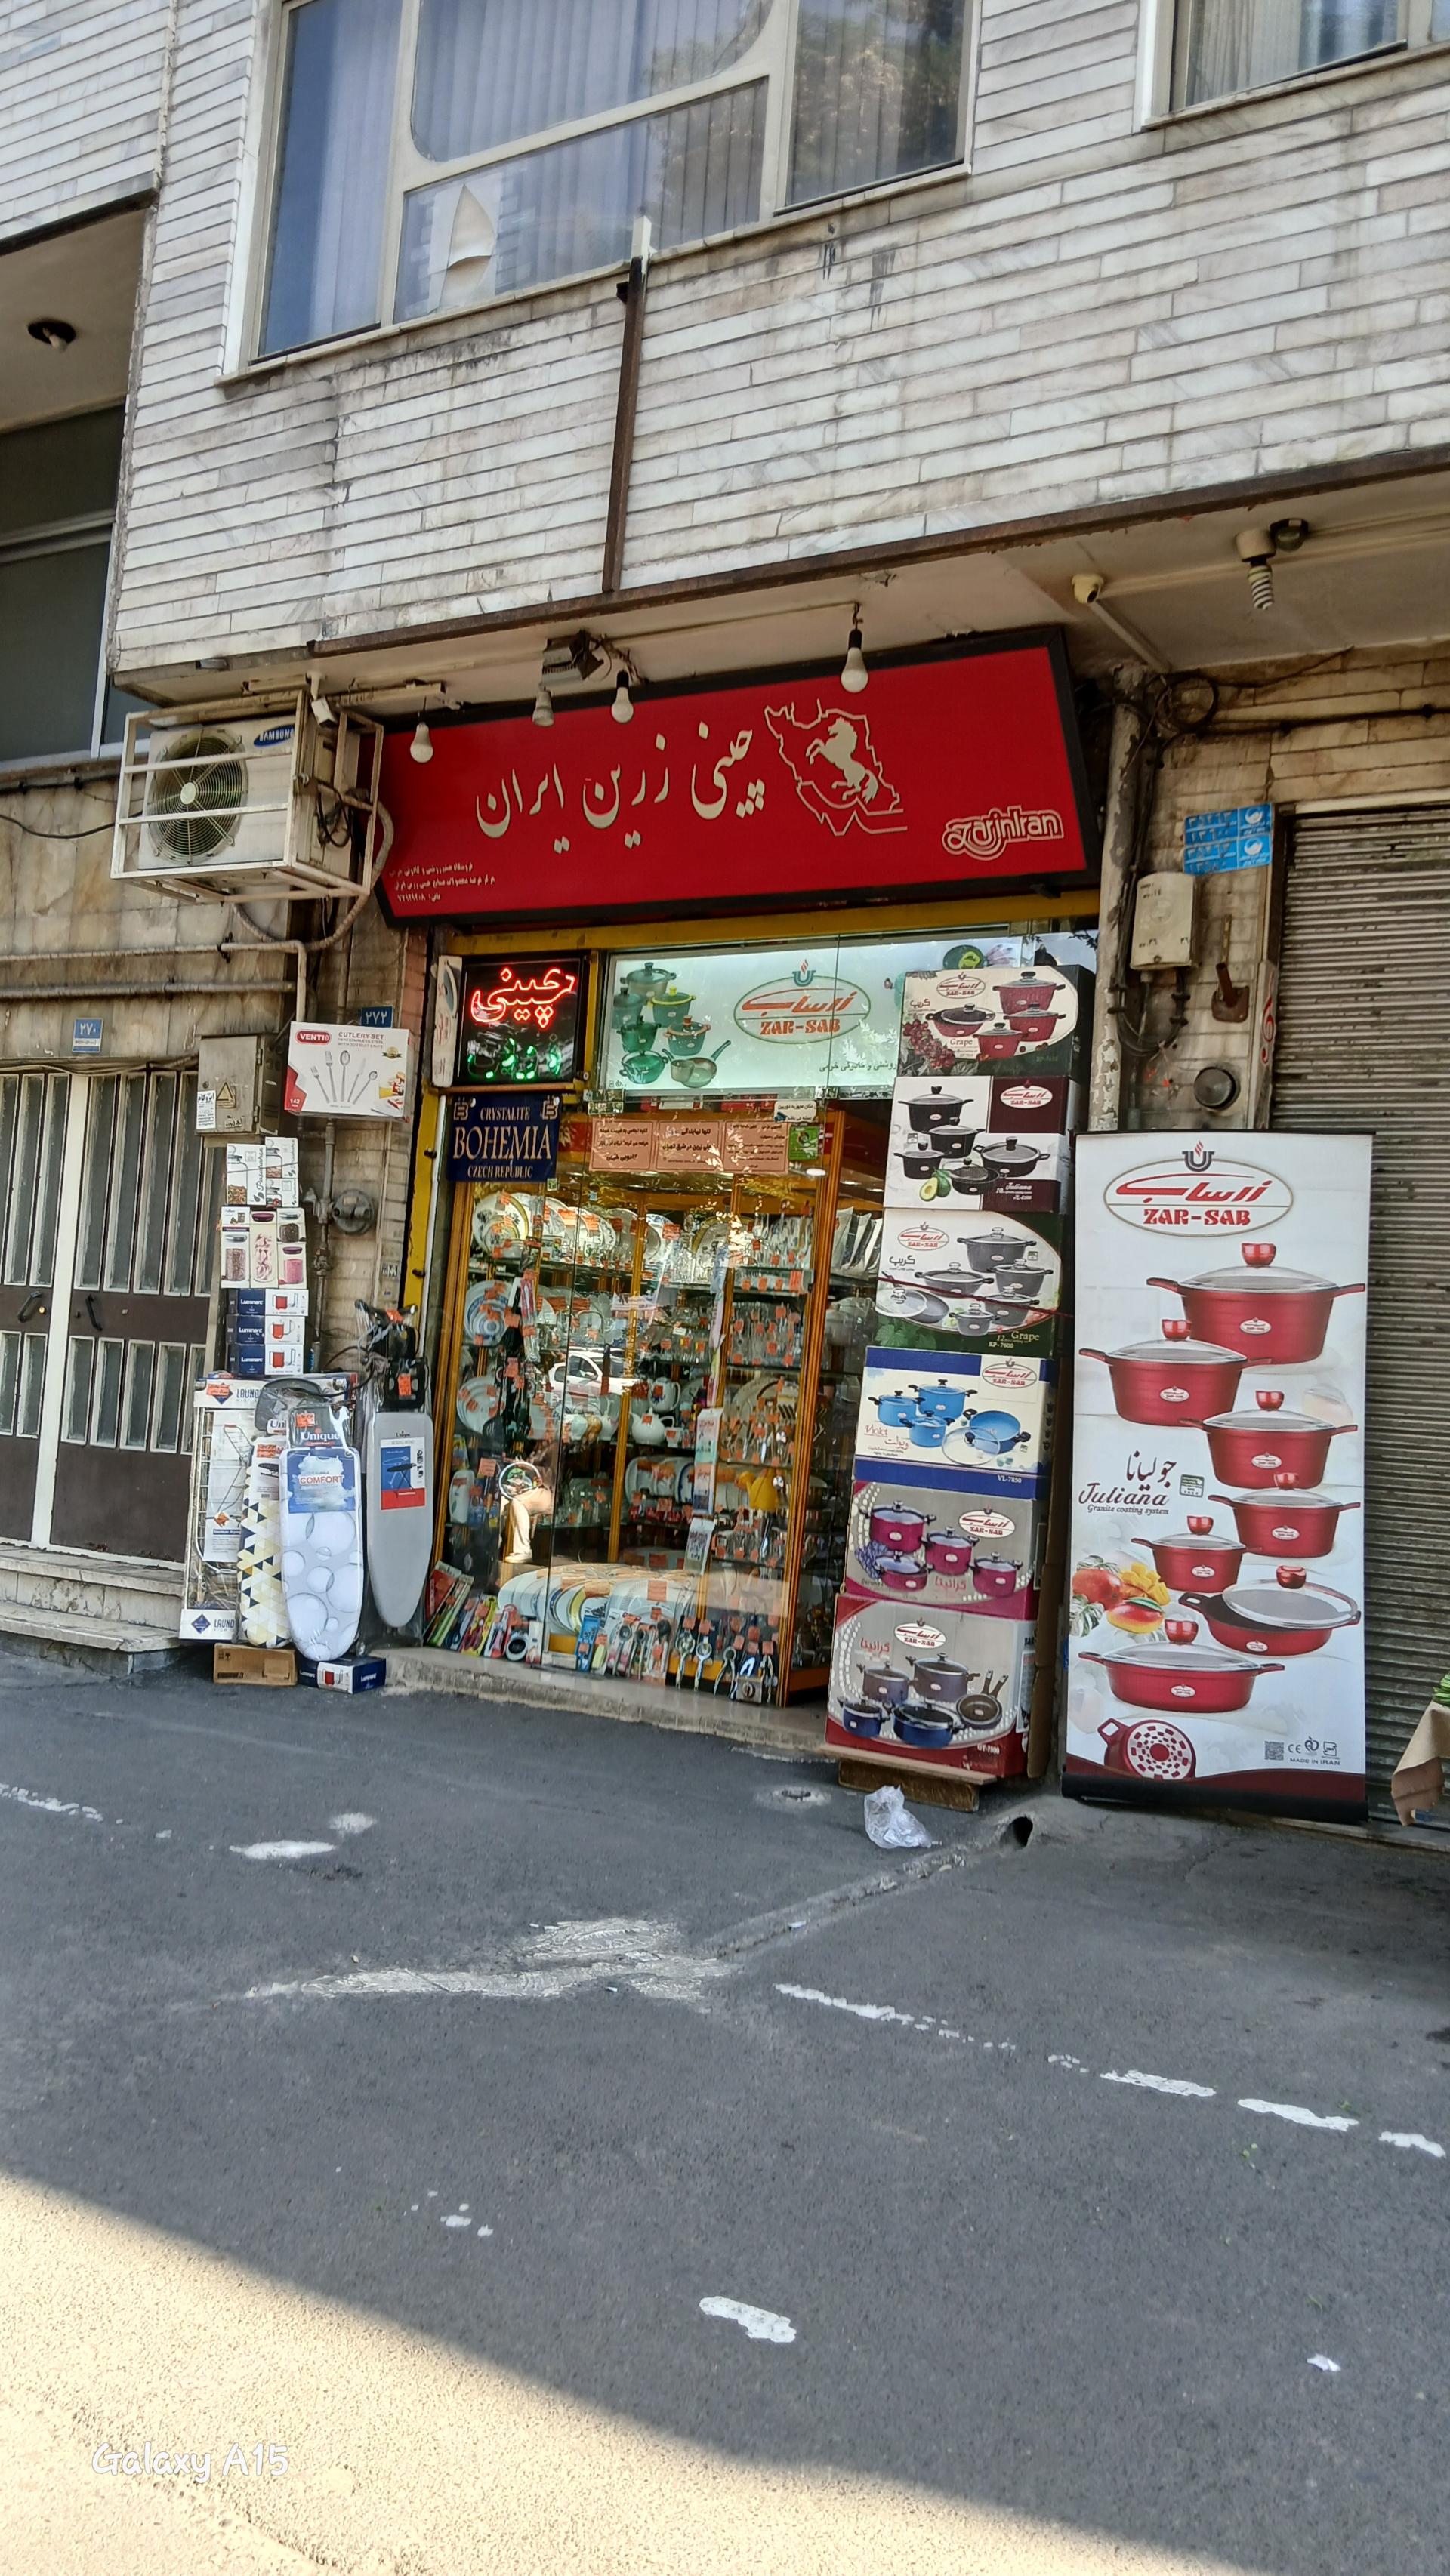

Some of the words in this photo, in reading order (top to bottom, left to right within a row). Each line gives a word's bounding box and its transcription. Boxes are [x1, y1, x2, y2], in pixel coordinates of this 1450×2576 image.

[691, 720, 765, 821] چینی
[582, 733, 670, 849] زرین
[476, 763, 570, 855] ایران
[760, 1018, 841, 1035] ZAR-SAB
[480, 1106, 530, 1121] CRYSTALITE
[452, 1124, 551, 1160] BOHEMIA
[467, 1165, 493, 1179] CZECH
[495, 1165, 533, 1179] REPUBLIC
[1143, 1209, 1251, 1226] ZAR-SAB
[1010, 1330, 1040, 1342] Grape
[236, 1388, 261, 1398] LAUND
[1126, 1450, 1177, 1491] جولیانا
[300, 1475, 344, 1484] COMFORT
[1078, 1482, 1170, 1506] Juliana
[1088, 1504, 1115, 1513] Granite
[1116, 1506, 1143, 1515] coating
